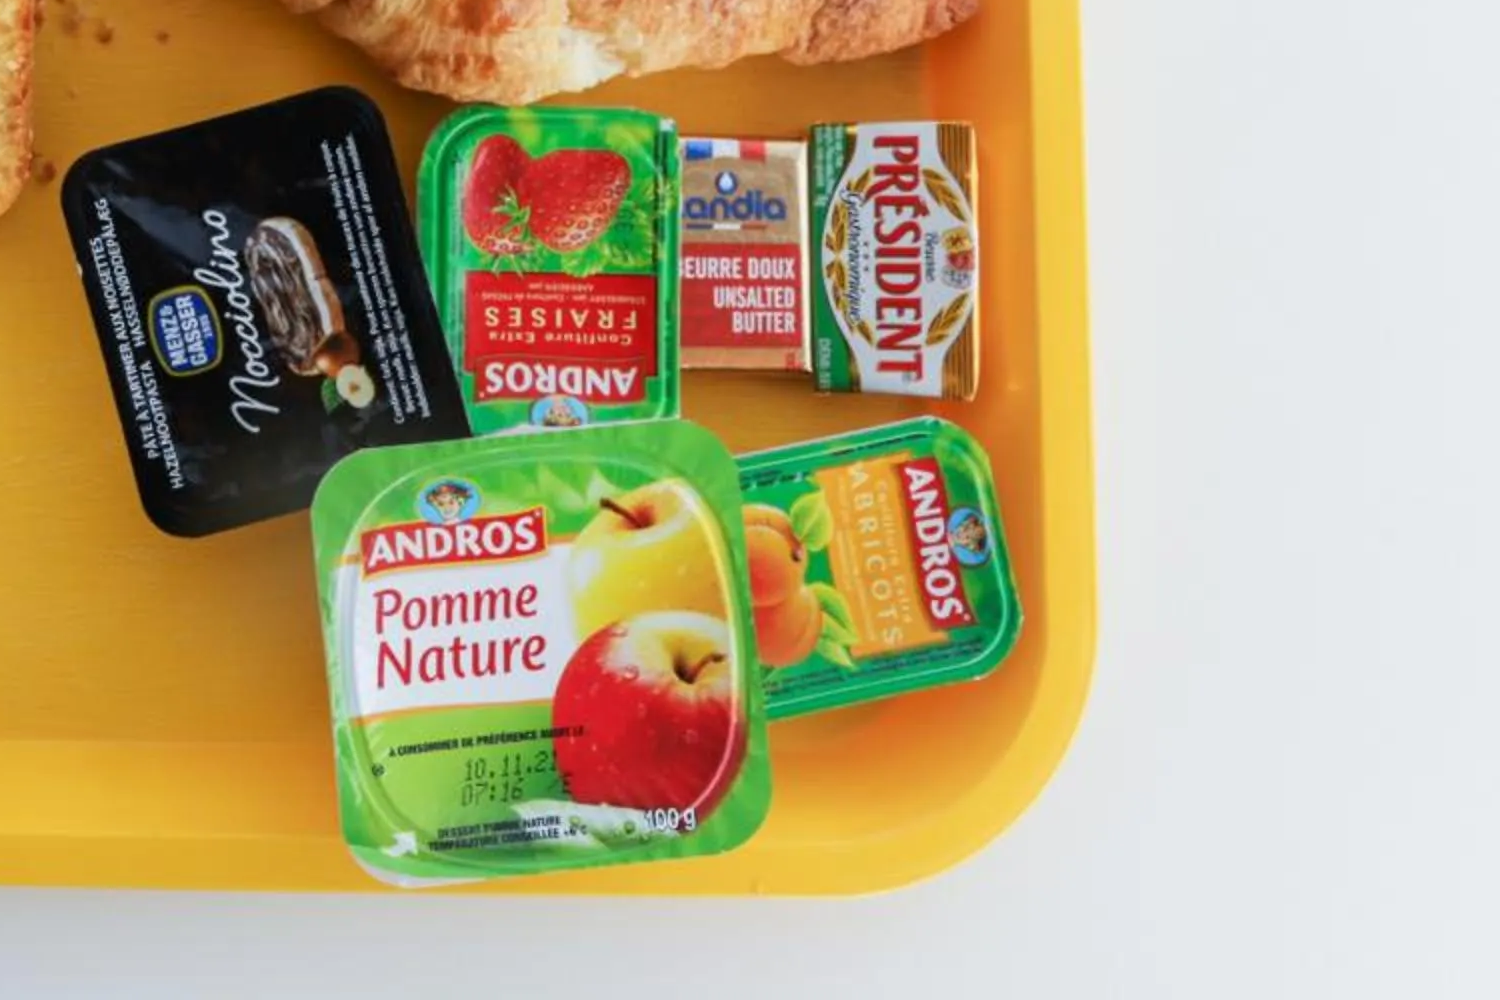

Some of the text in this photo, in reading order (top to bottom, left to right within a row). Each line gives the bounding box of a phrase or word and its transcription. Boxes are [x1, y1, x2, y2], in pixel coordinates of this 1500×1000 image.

[681, 187, 787, 223] andia
[88, 235, 121, 310] NOISETTES
[747, 255, 796, 280] DOUX
[865, 134, 929, 381] PRÉSIDENT
[193, 208, 281, 434] Nocciolino
[484, 306, 636, 329] FRAISES
[712, 285, 796, 311] UNSALTED
[731, 310, 796, 335] BUTTER
[109, 310, 129, 341] AUX
[176, 295, 208, 366] GASSER
[488, 330, 632, 345] Confiture Extra
[117, 340, 148, 411] TARTINER
[483, 361, 637, 396] ANDROS
[138, 358, 186, 490] HAZELNOOTPASTA
[366, 519, 537, 569] ANDROS
[849, 464, 904, 646] ABRICOTS
[903, 465, 964, 622] ANDROS
[373, 582, 539, 636] Pomme
[375, 630, 547, 690] Nature
[641, 803, 699, 833] 100 g
